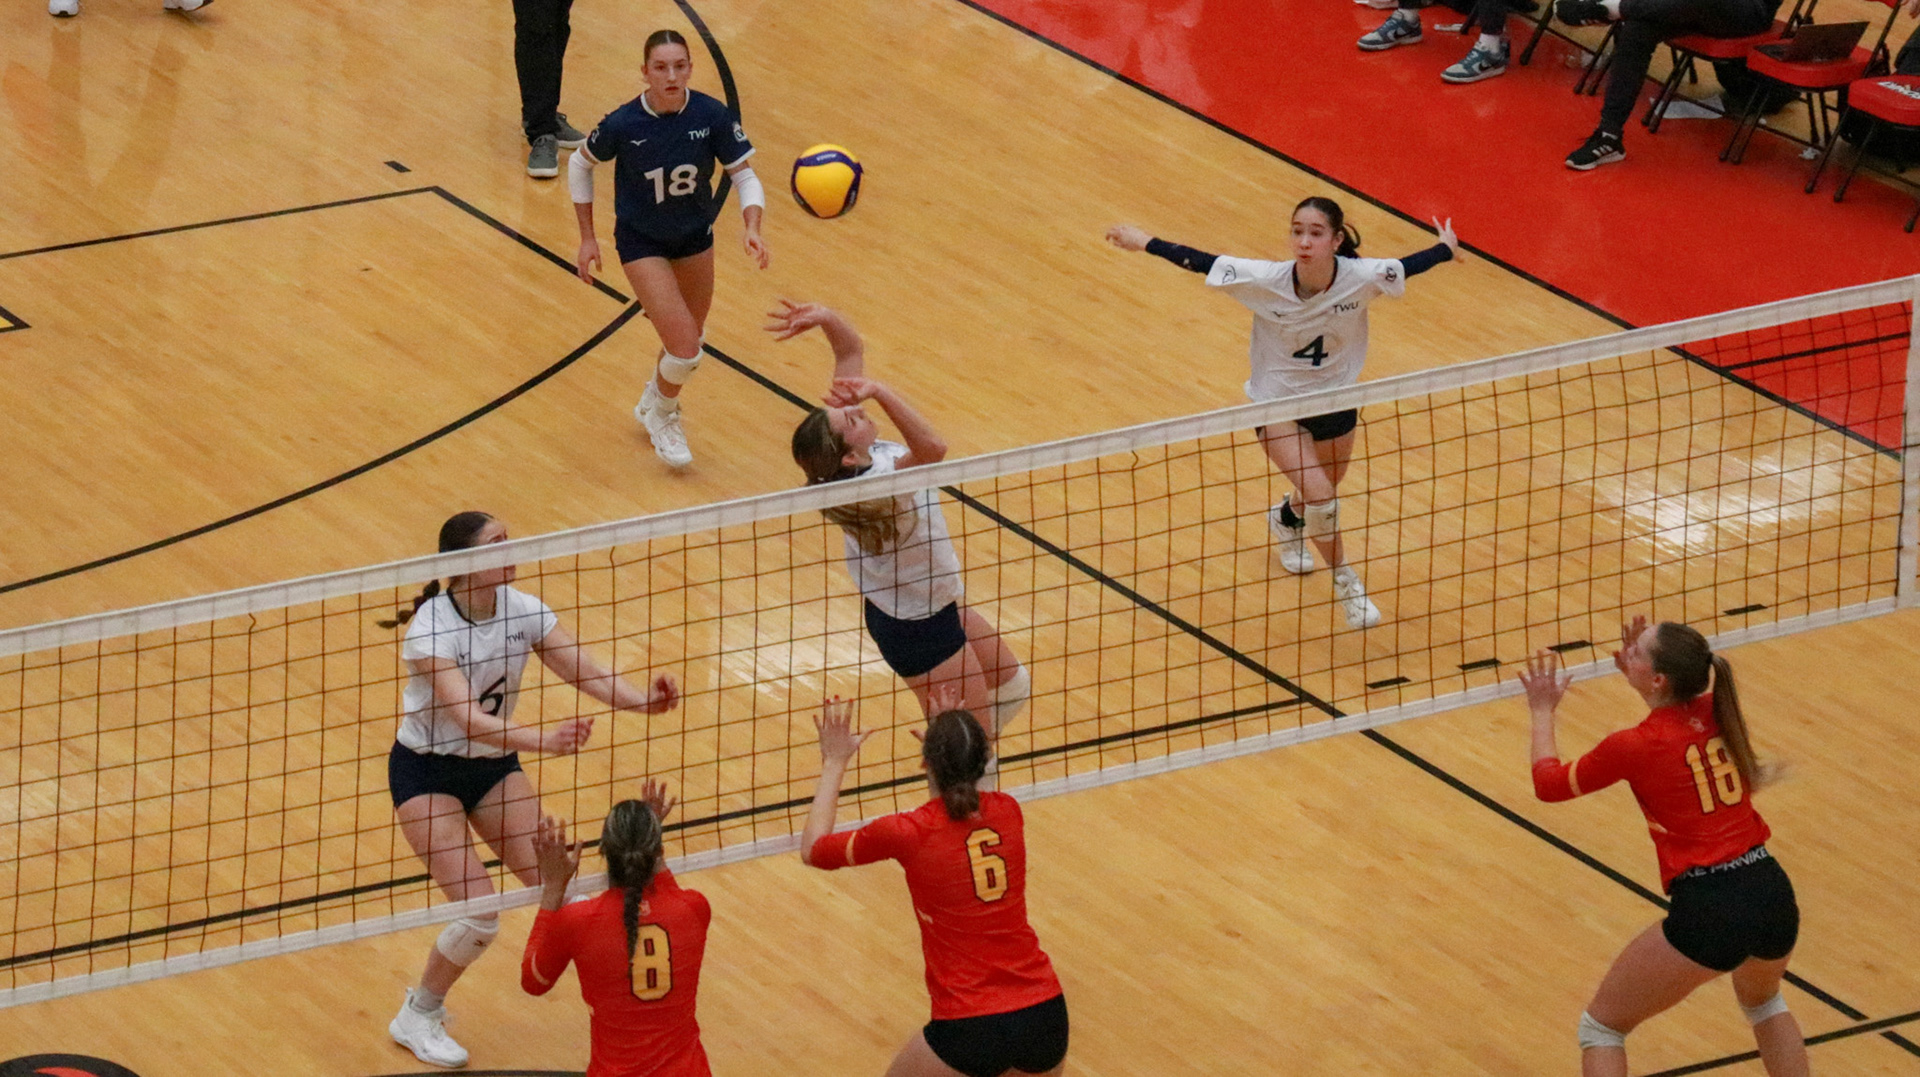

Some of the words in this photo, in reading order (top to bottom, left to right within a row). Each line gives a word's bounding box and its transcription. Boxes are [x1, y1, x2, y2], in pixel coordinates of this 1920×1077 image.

[643, 163, 699, 205] 18
[1333, 301, 1360, 314] TWU
[1292, 334, 1329, 367] 4
[1684, 735, 1744, 814] 18
[965, 826, 1008, 904] 6
[629, 922, 673, 1003] 8
